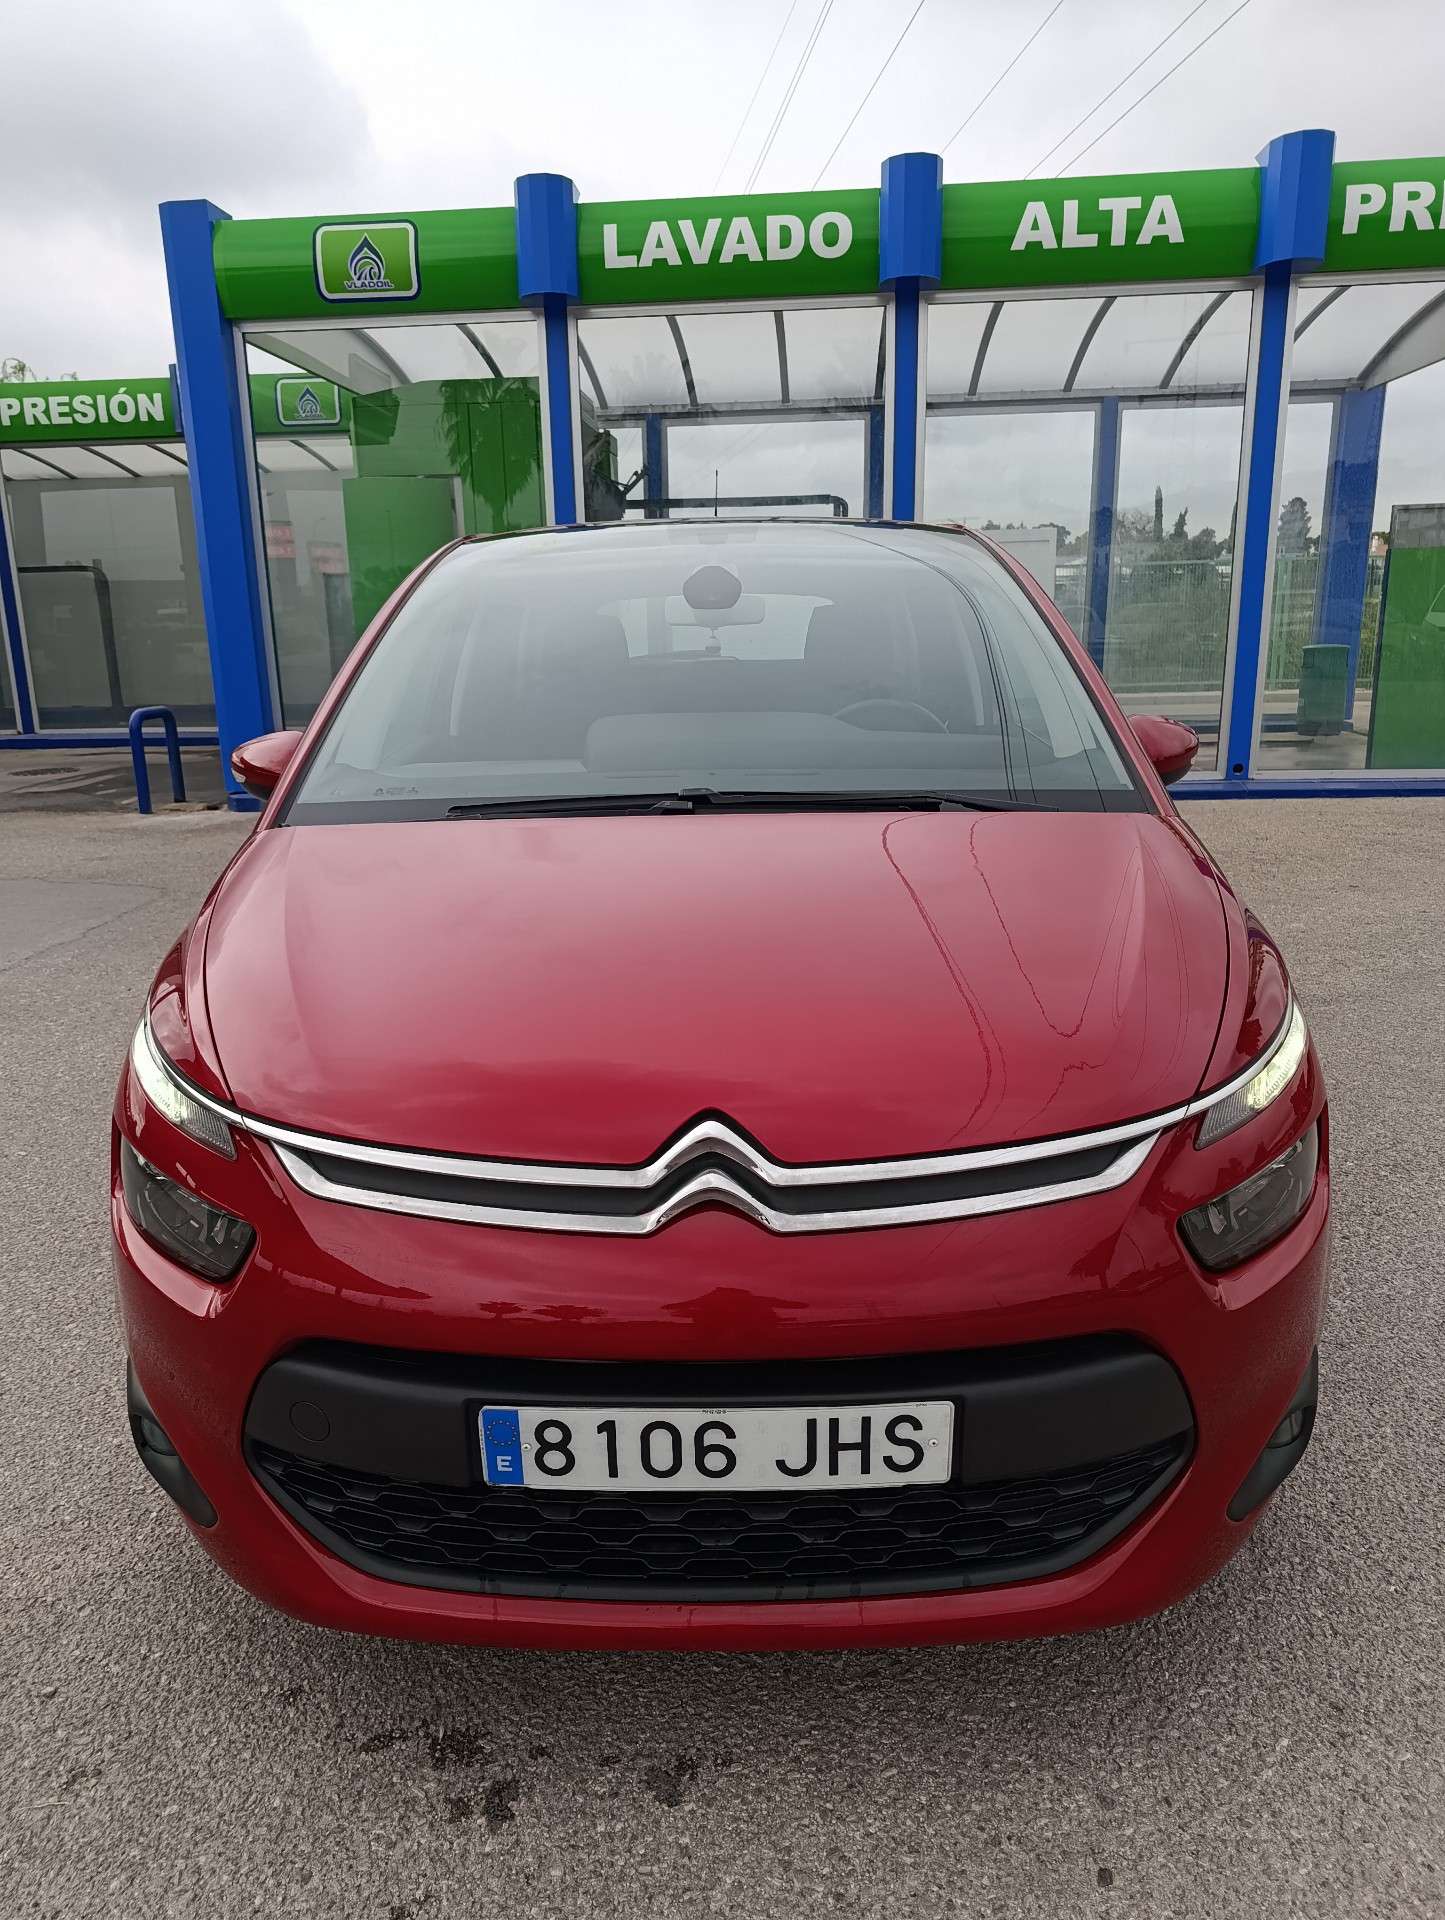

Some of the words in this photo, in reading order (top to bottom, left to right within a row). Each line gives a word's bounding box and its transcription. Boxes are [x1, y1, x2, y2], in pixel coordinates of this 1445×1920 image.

[602, 211, 853, 270] LAVADO
[1010, 194, 1185, 252] ALTA
[1342, 180, 1445, 235] PR
[344, 279, 394, 289] VLADOIL
[0, 387, 165, 426] PRESIÓN
[496, 1455, 513, 1472] E
[534, 1419, 737, 1478] 8106
[775, 1414, 925, 1477] JHS
